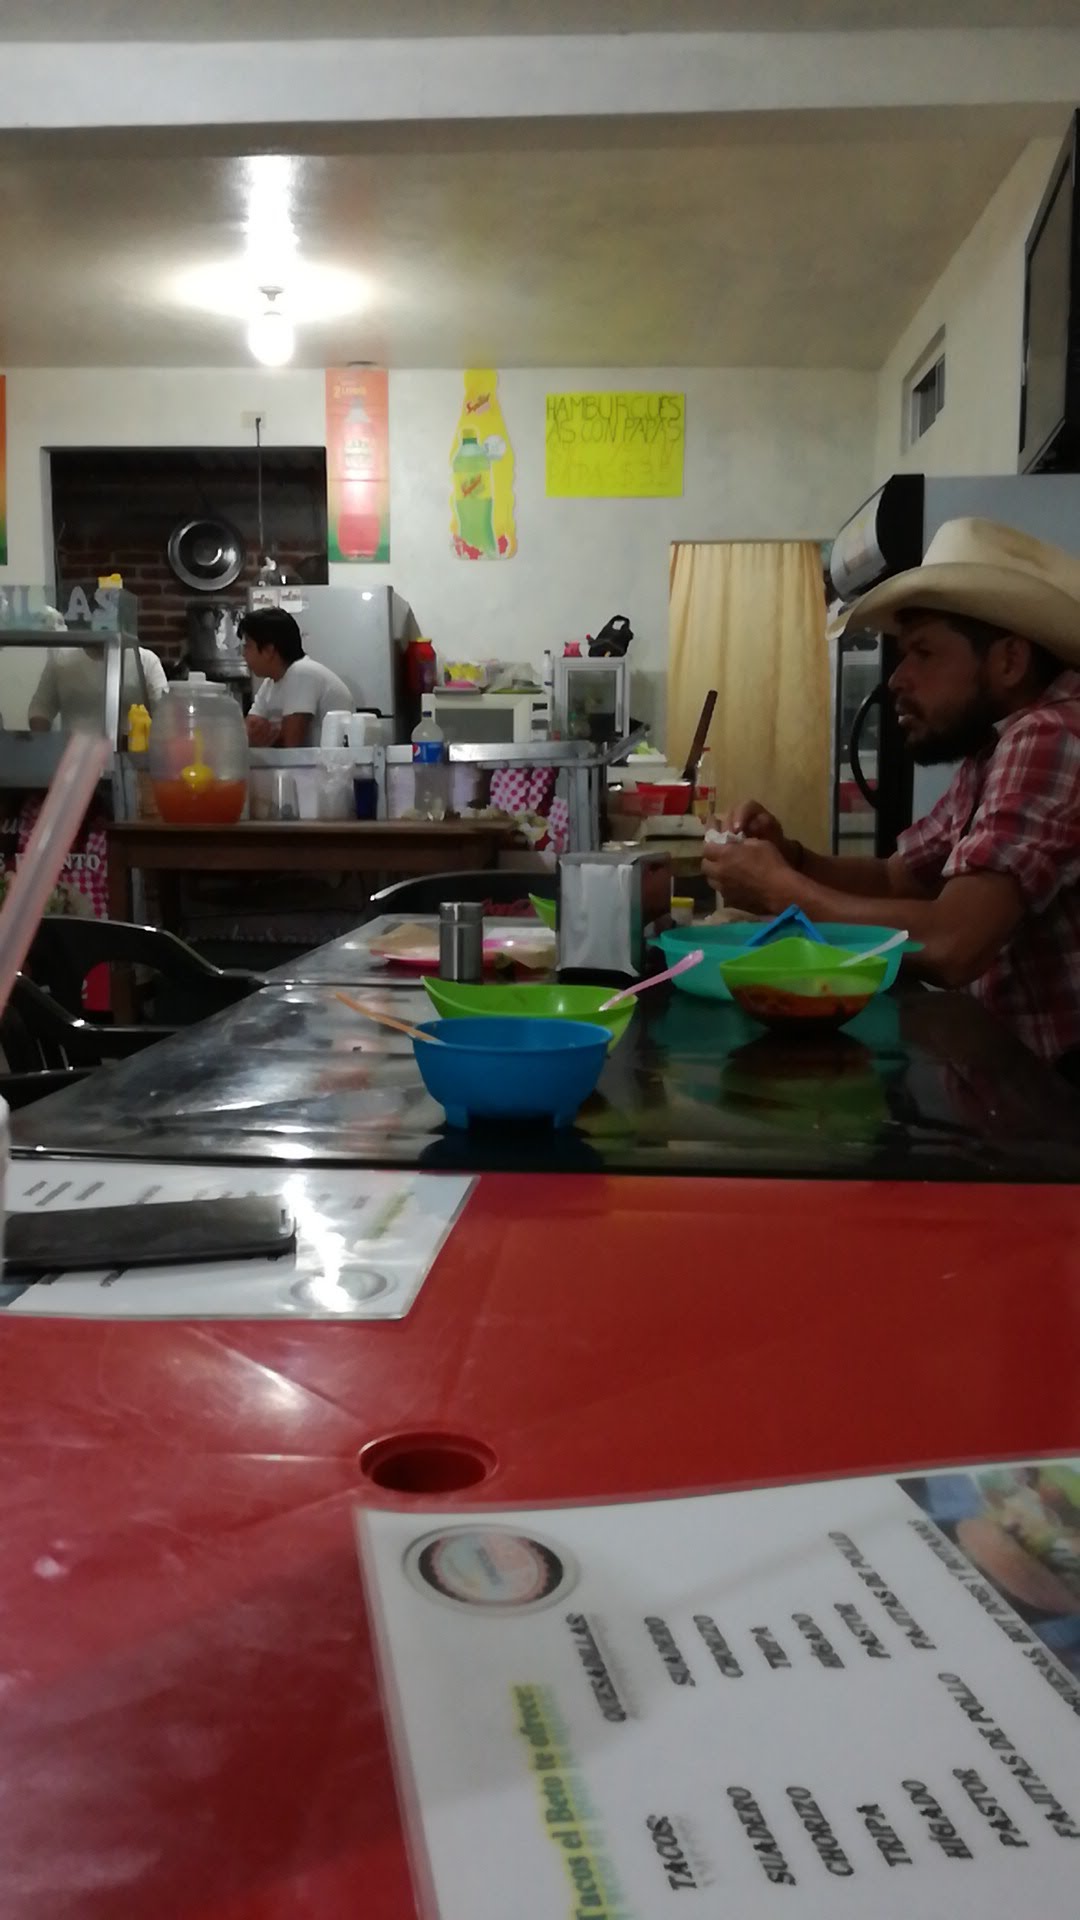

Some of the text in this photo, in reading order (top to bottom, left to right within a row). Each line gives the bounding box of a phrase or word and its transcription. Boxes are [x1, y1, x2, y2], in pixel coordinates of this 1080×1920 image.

[565, 1612, 627, 1723] QUESADILLAS
[643, 1616, 696, 1688] SUADERO
[833, 1602, 892, 1660] PASTOR
[938, 1671, 1080, 1839] FAJITAS DE POLLO
[542, 1775, 575, 1824] Beto
[726, 1785, 797, 1887] SUADERO
[785, 1785, 855, 1878] CHORIZO
[856, 1803, 914, 1869] TRIPA
[951, 1767, 1030, 1849] PASTOR
[646, 1813, 698, 1892] TACOS
